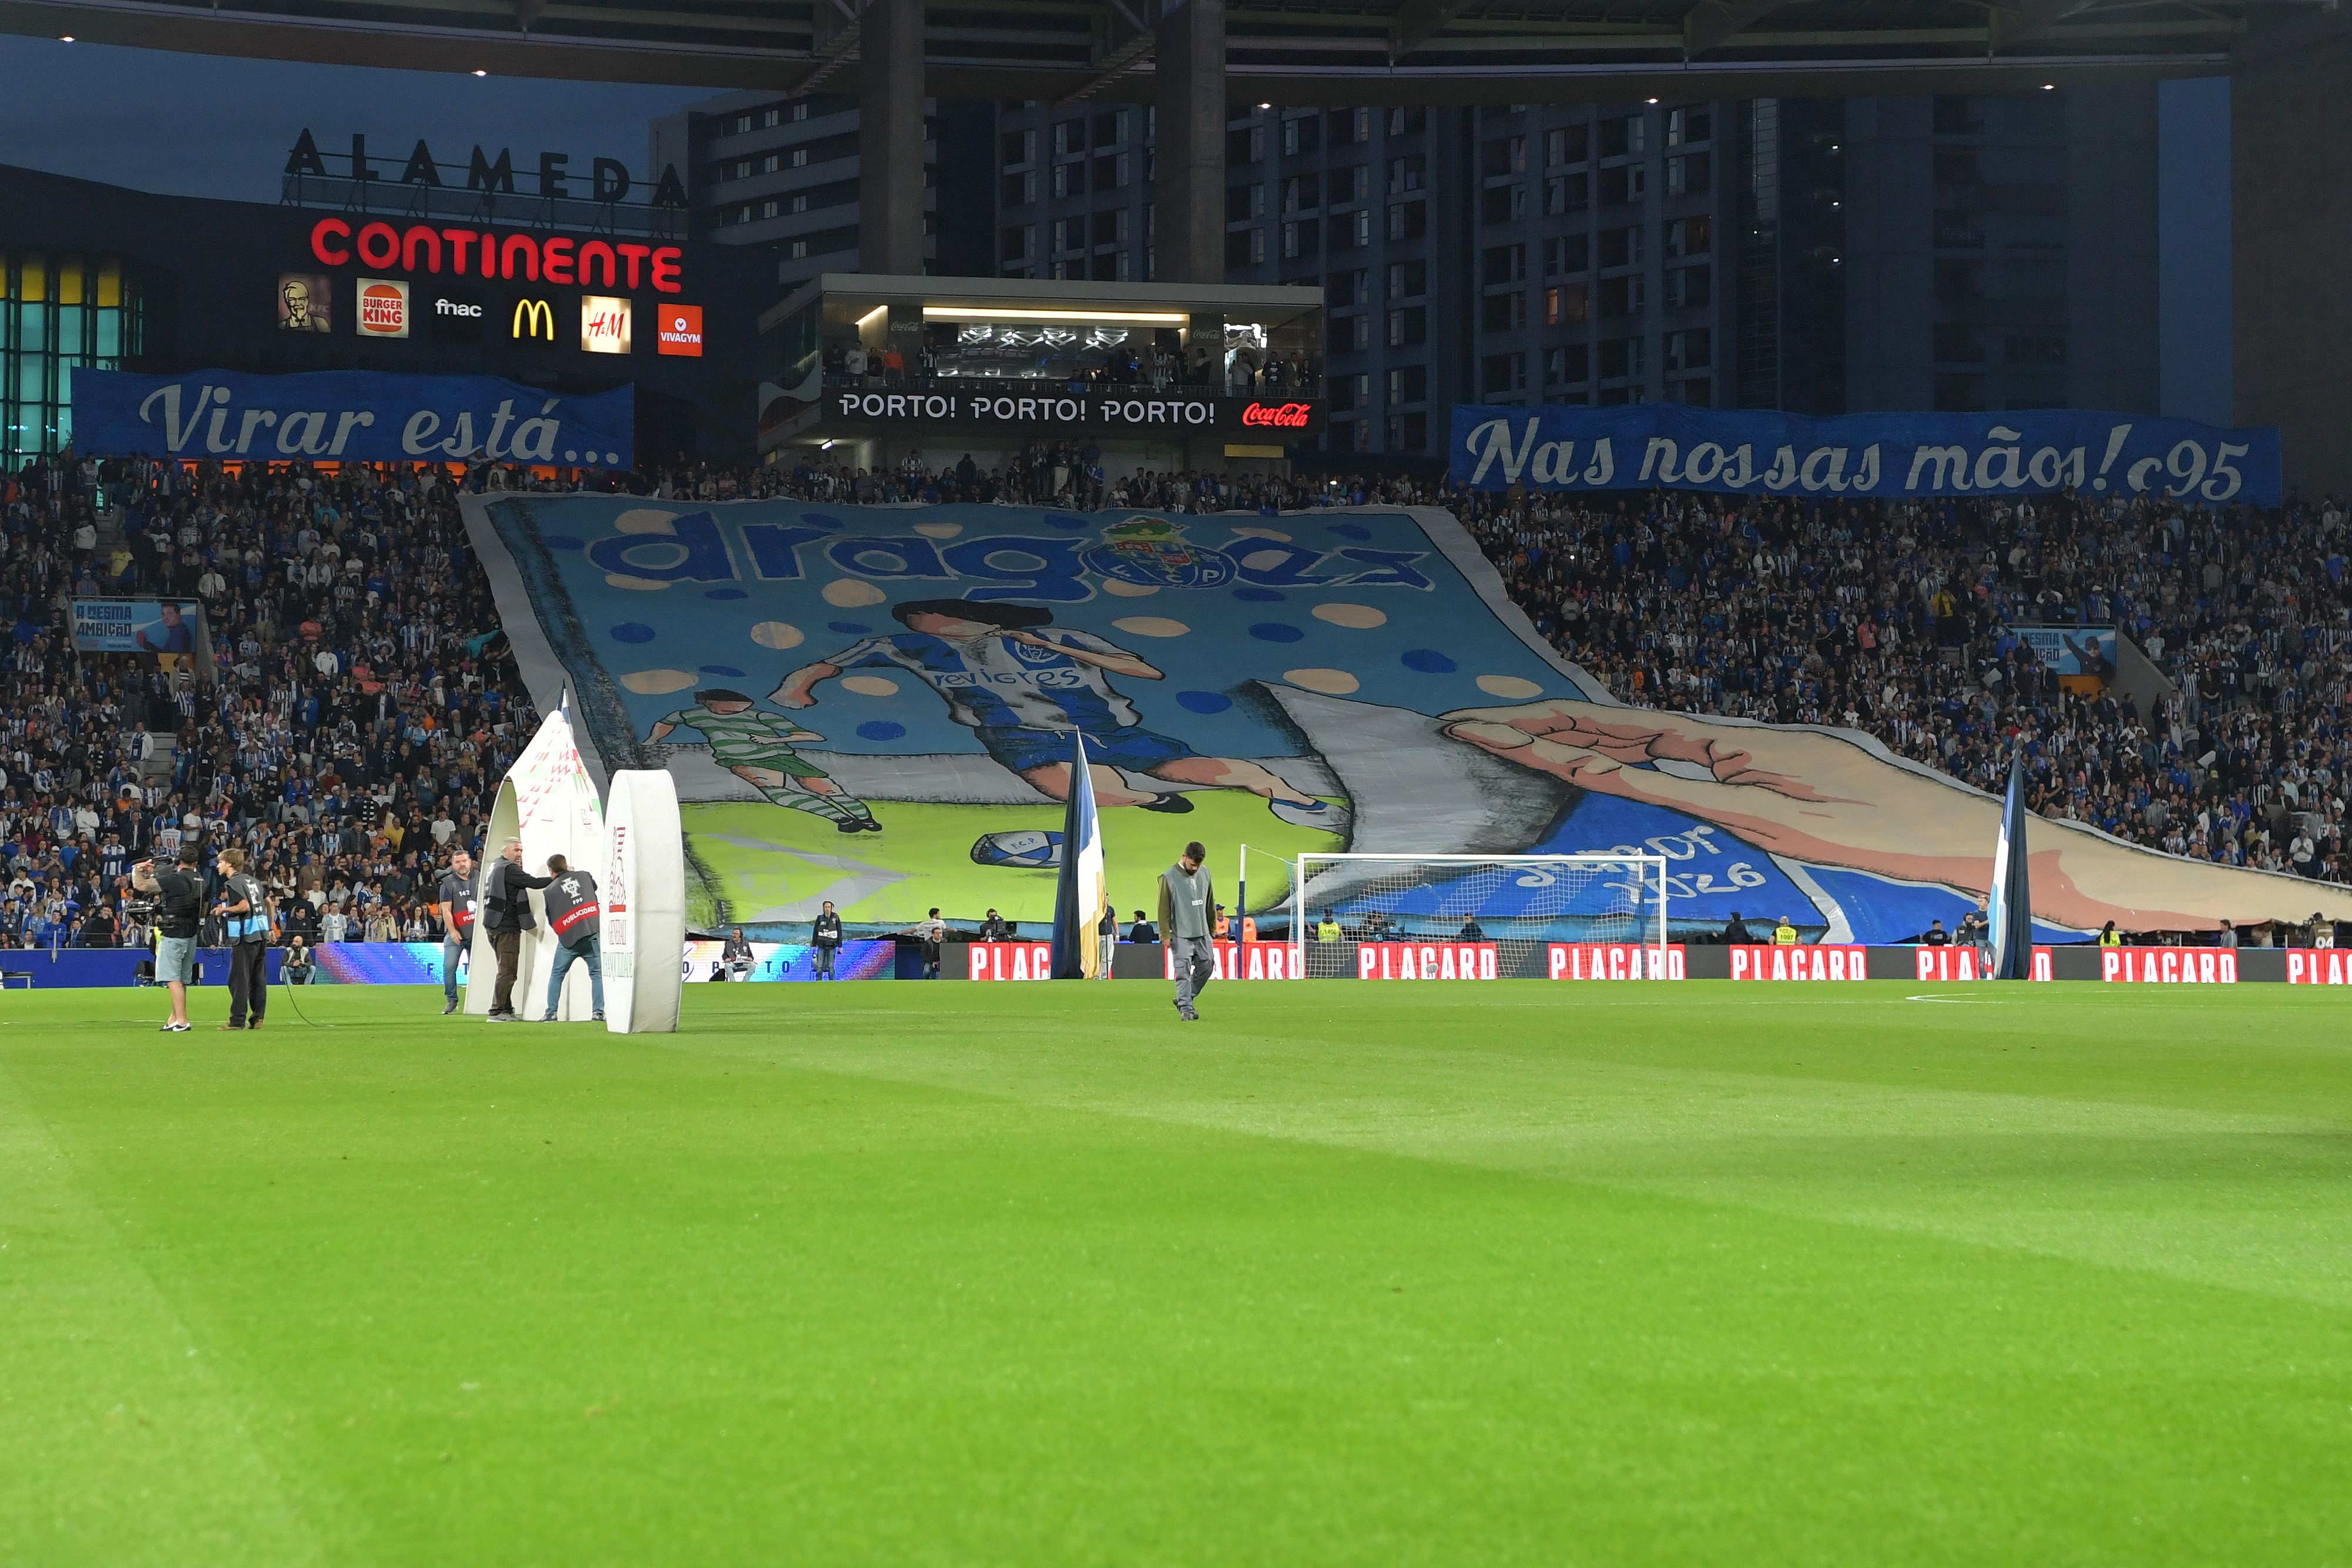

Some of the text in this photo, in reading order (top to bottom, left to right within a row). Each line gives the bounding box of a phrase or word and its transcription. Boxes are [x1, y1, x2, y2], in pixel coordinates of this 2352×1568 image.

[284, 128, 689, 207] ALAMEDA
[311, 218, 682, 293] CONTINENTE
[309, 304, 330, 313] KFC
[363, 298, 402, 310] BURGER
[435, 298, 482, 317] fnac
[363, 308, 402, 324] KING
[588, 311, 625, 340] H&M
[660, 331, 701, 344] VIVAGYM
[839, 394, 1214, 425] PORTO! PORTO! PORTO!
[1243, 402, 1311, 427] Coca-Cola
[139, 384, 619, 465] Virar está...
[1466, 416, 1616, 485] Nas
[1638, 437, 1880, 492] nossas
[1905, 423, 2133, 491] mãos!
[76, 605, 84, 619] A
[76, 622, 132, 637] AMBIÇÃO
[562, 905, 598, 926] PUBLICIDADE
[1551, 948, 1684, 981] PLACARD
